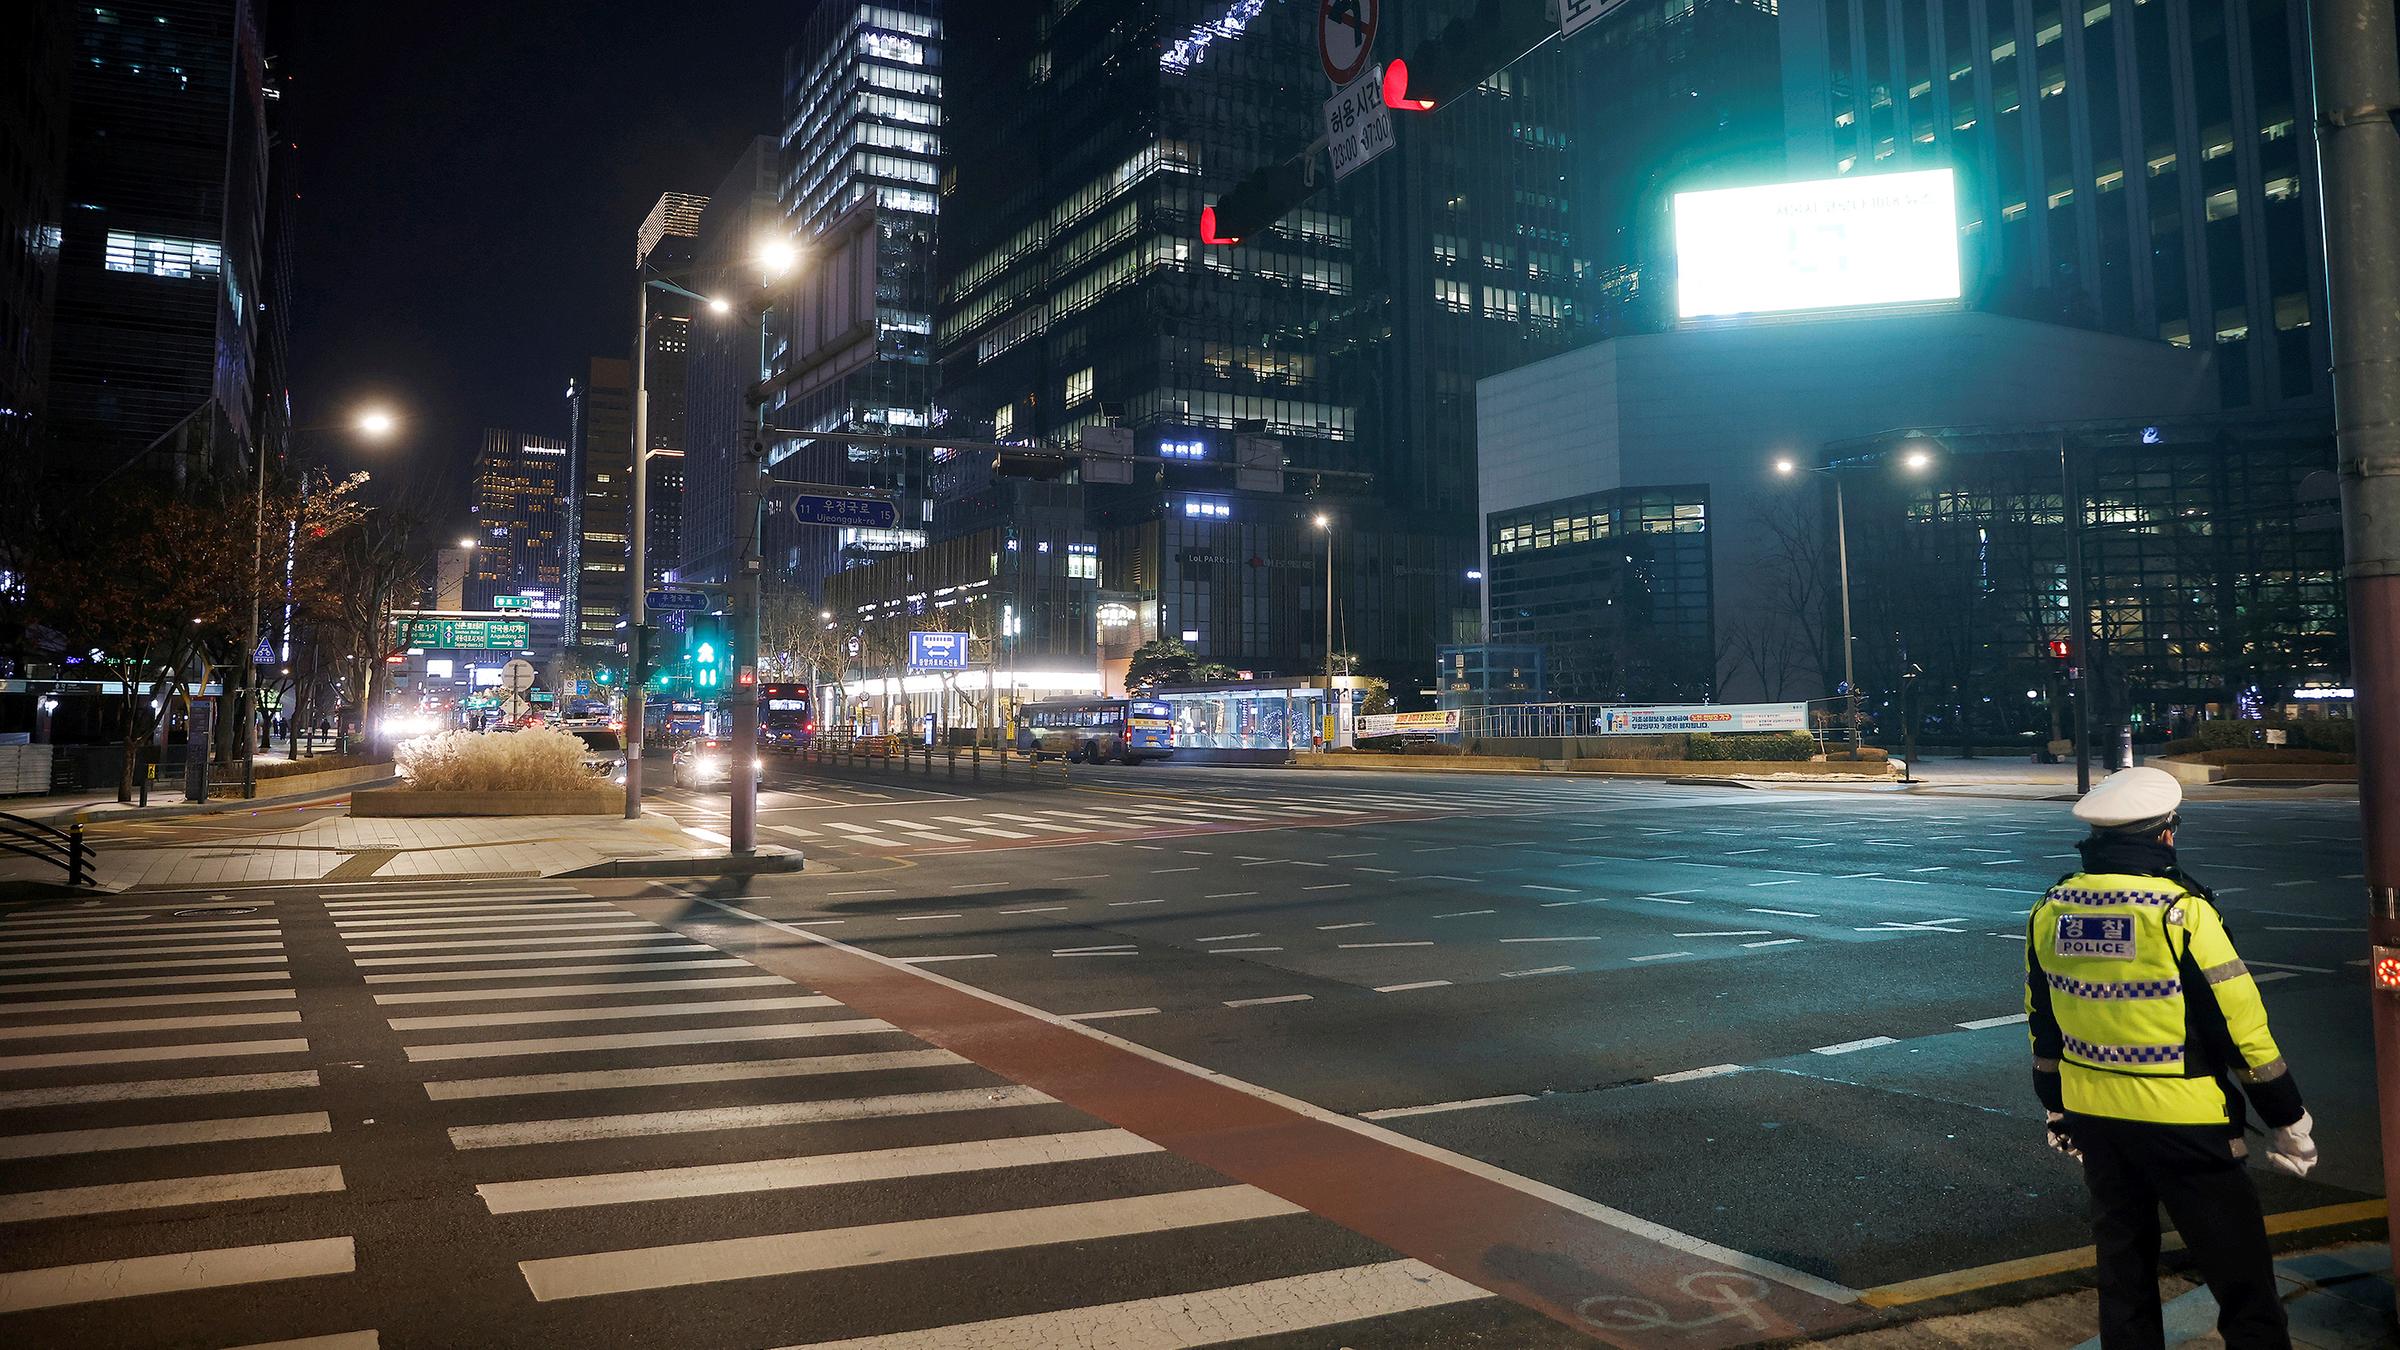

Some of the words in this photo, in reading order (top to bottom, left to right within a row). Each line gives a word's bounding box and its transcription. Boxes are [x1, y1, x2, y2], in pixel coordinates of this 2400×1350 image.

[1331, 77, 1381, 133] 허용시간
[800, 504, 810, 514] 11
[823, 499, 870, 514] 우정국로
[816, 513, 876, 526] Ujeongguk-ro
[881, 510, 891, 520] 15
[1189, 554, 1204, 563] LoL
[1206, 555, 1225, 564] PARK
[2066, 919, 2124, 939] 경찰
[2064, 942, 2125, 953] POLICE
